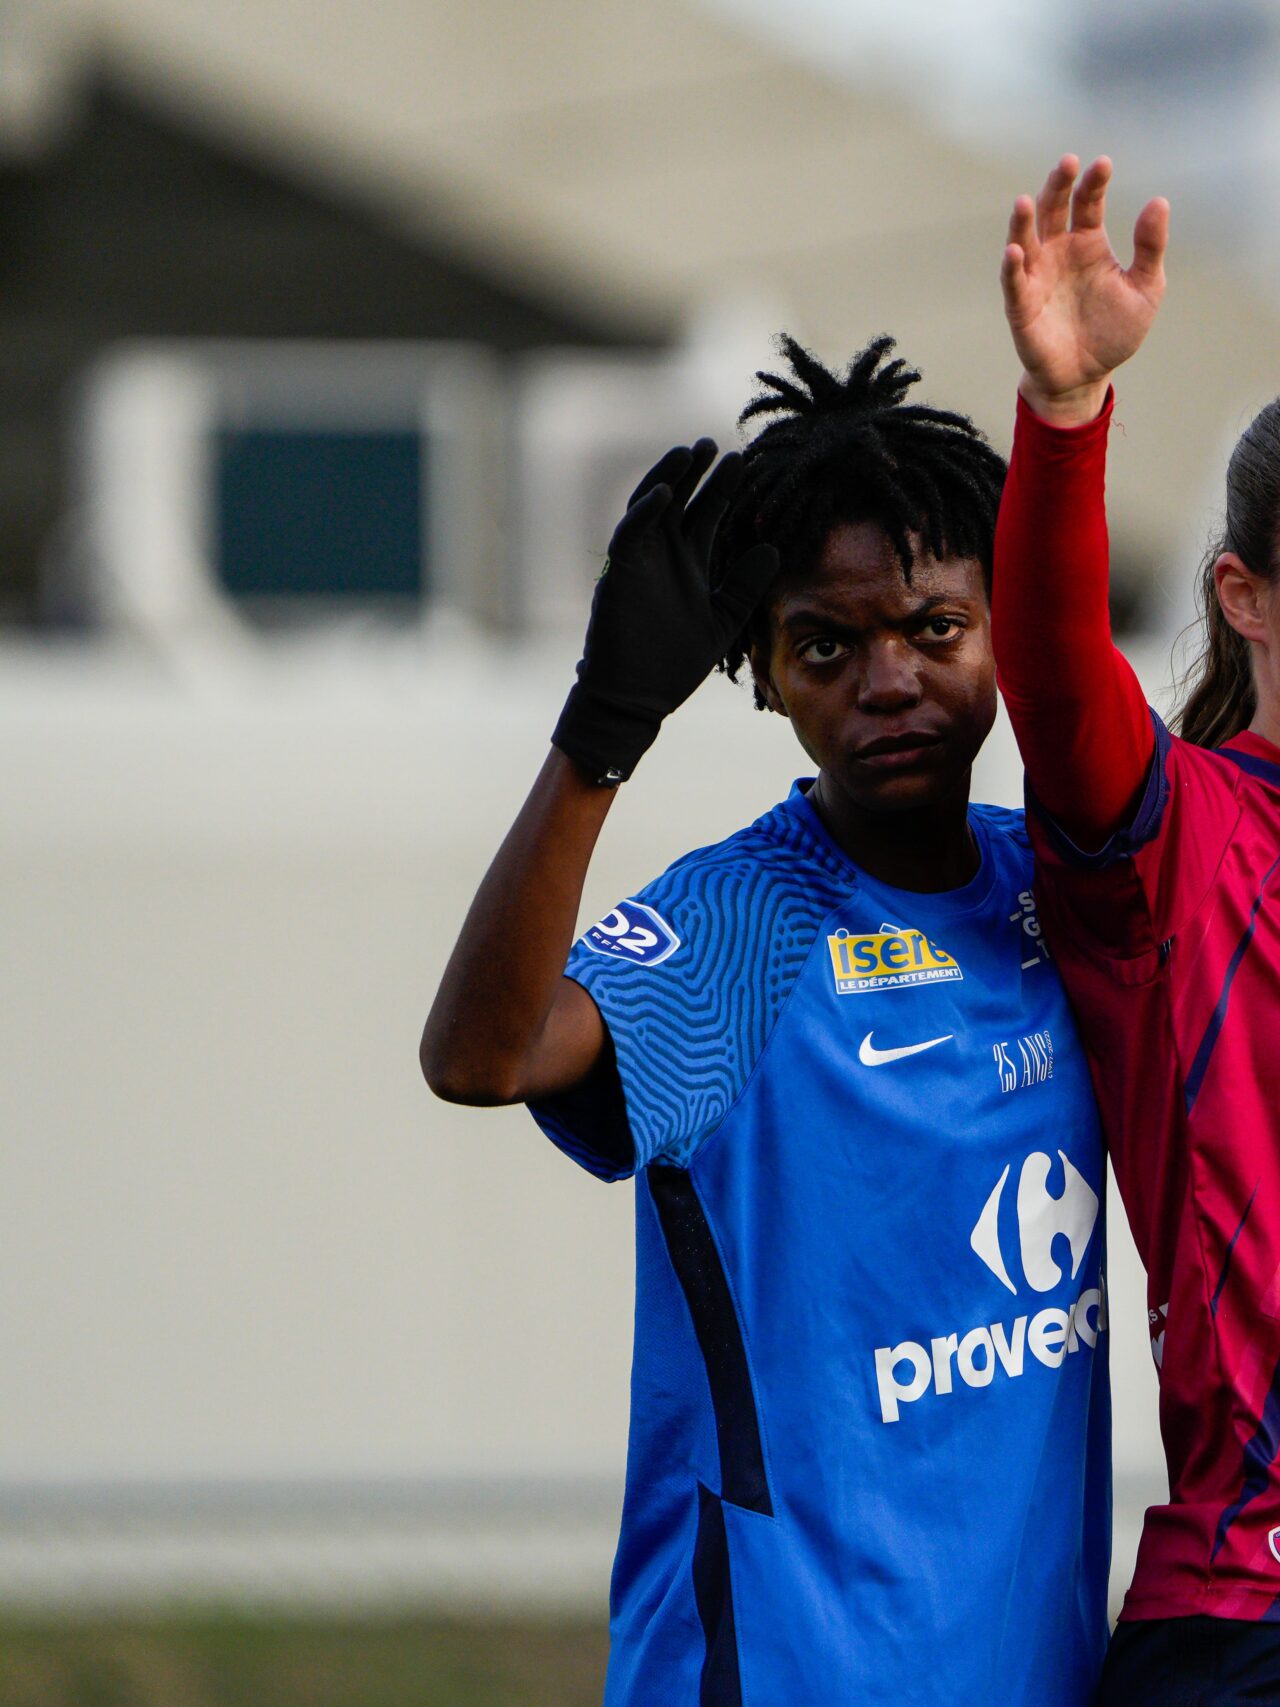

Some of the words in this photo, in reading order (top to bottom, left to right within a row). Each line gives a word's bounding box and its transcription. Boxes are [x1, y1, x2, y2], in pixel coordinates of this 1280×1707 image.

[592, 931, 622, 951] FFF
[840, 980, 857, 989] LE
[859, 968, 959, 988] DÉPARTEMENT
[1018, 1033, 1048, 1088] ANS
